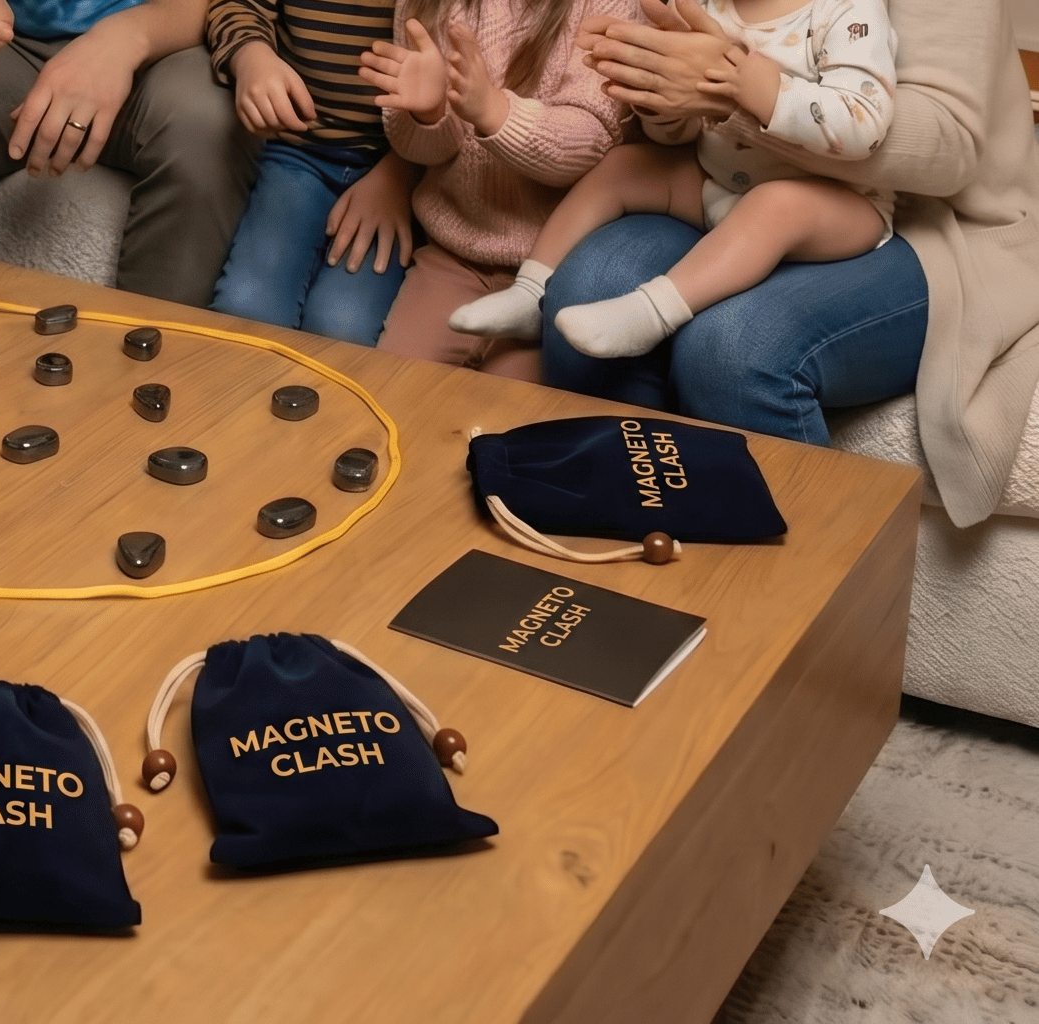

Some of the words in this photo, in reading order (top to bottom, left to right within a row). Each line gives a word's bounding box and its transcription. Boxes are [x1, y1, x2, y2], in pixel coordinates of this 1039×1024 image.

[621, 420, 663, 507] MAGNETO
[651, 432, 688, 489] CLASH
[498, 586, 575, 653] MAGNETO
[539, 603, 592, 647] CLASH
[229, 711, 401, 758] MAGNETO
[271, 742, 385, 777] CLASH
